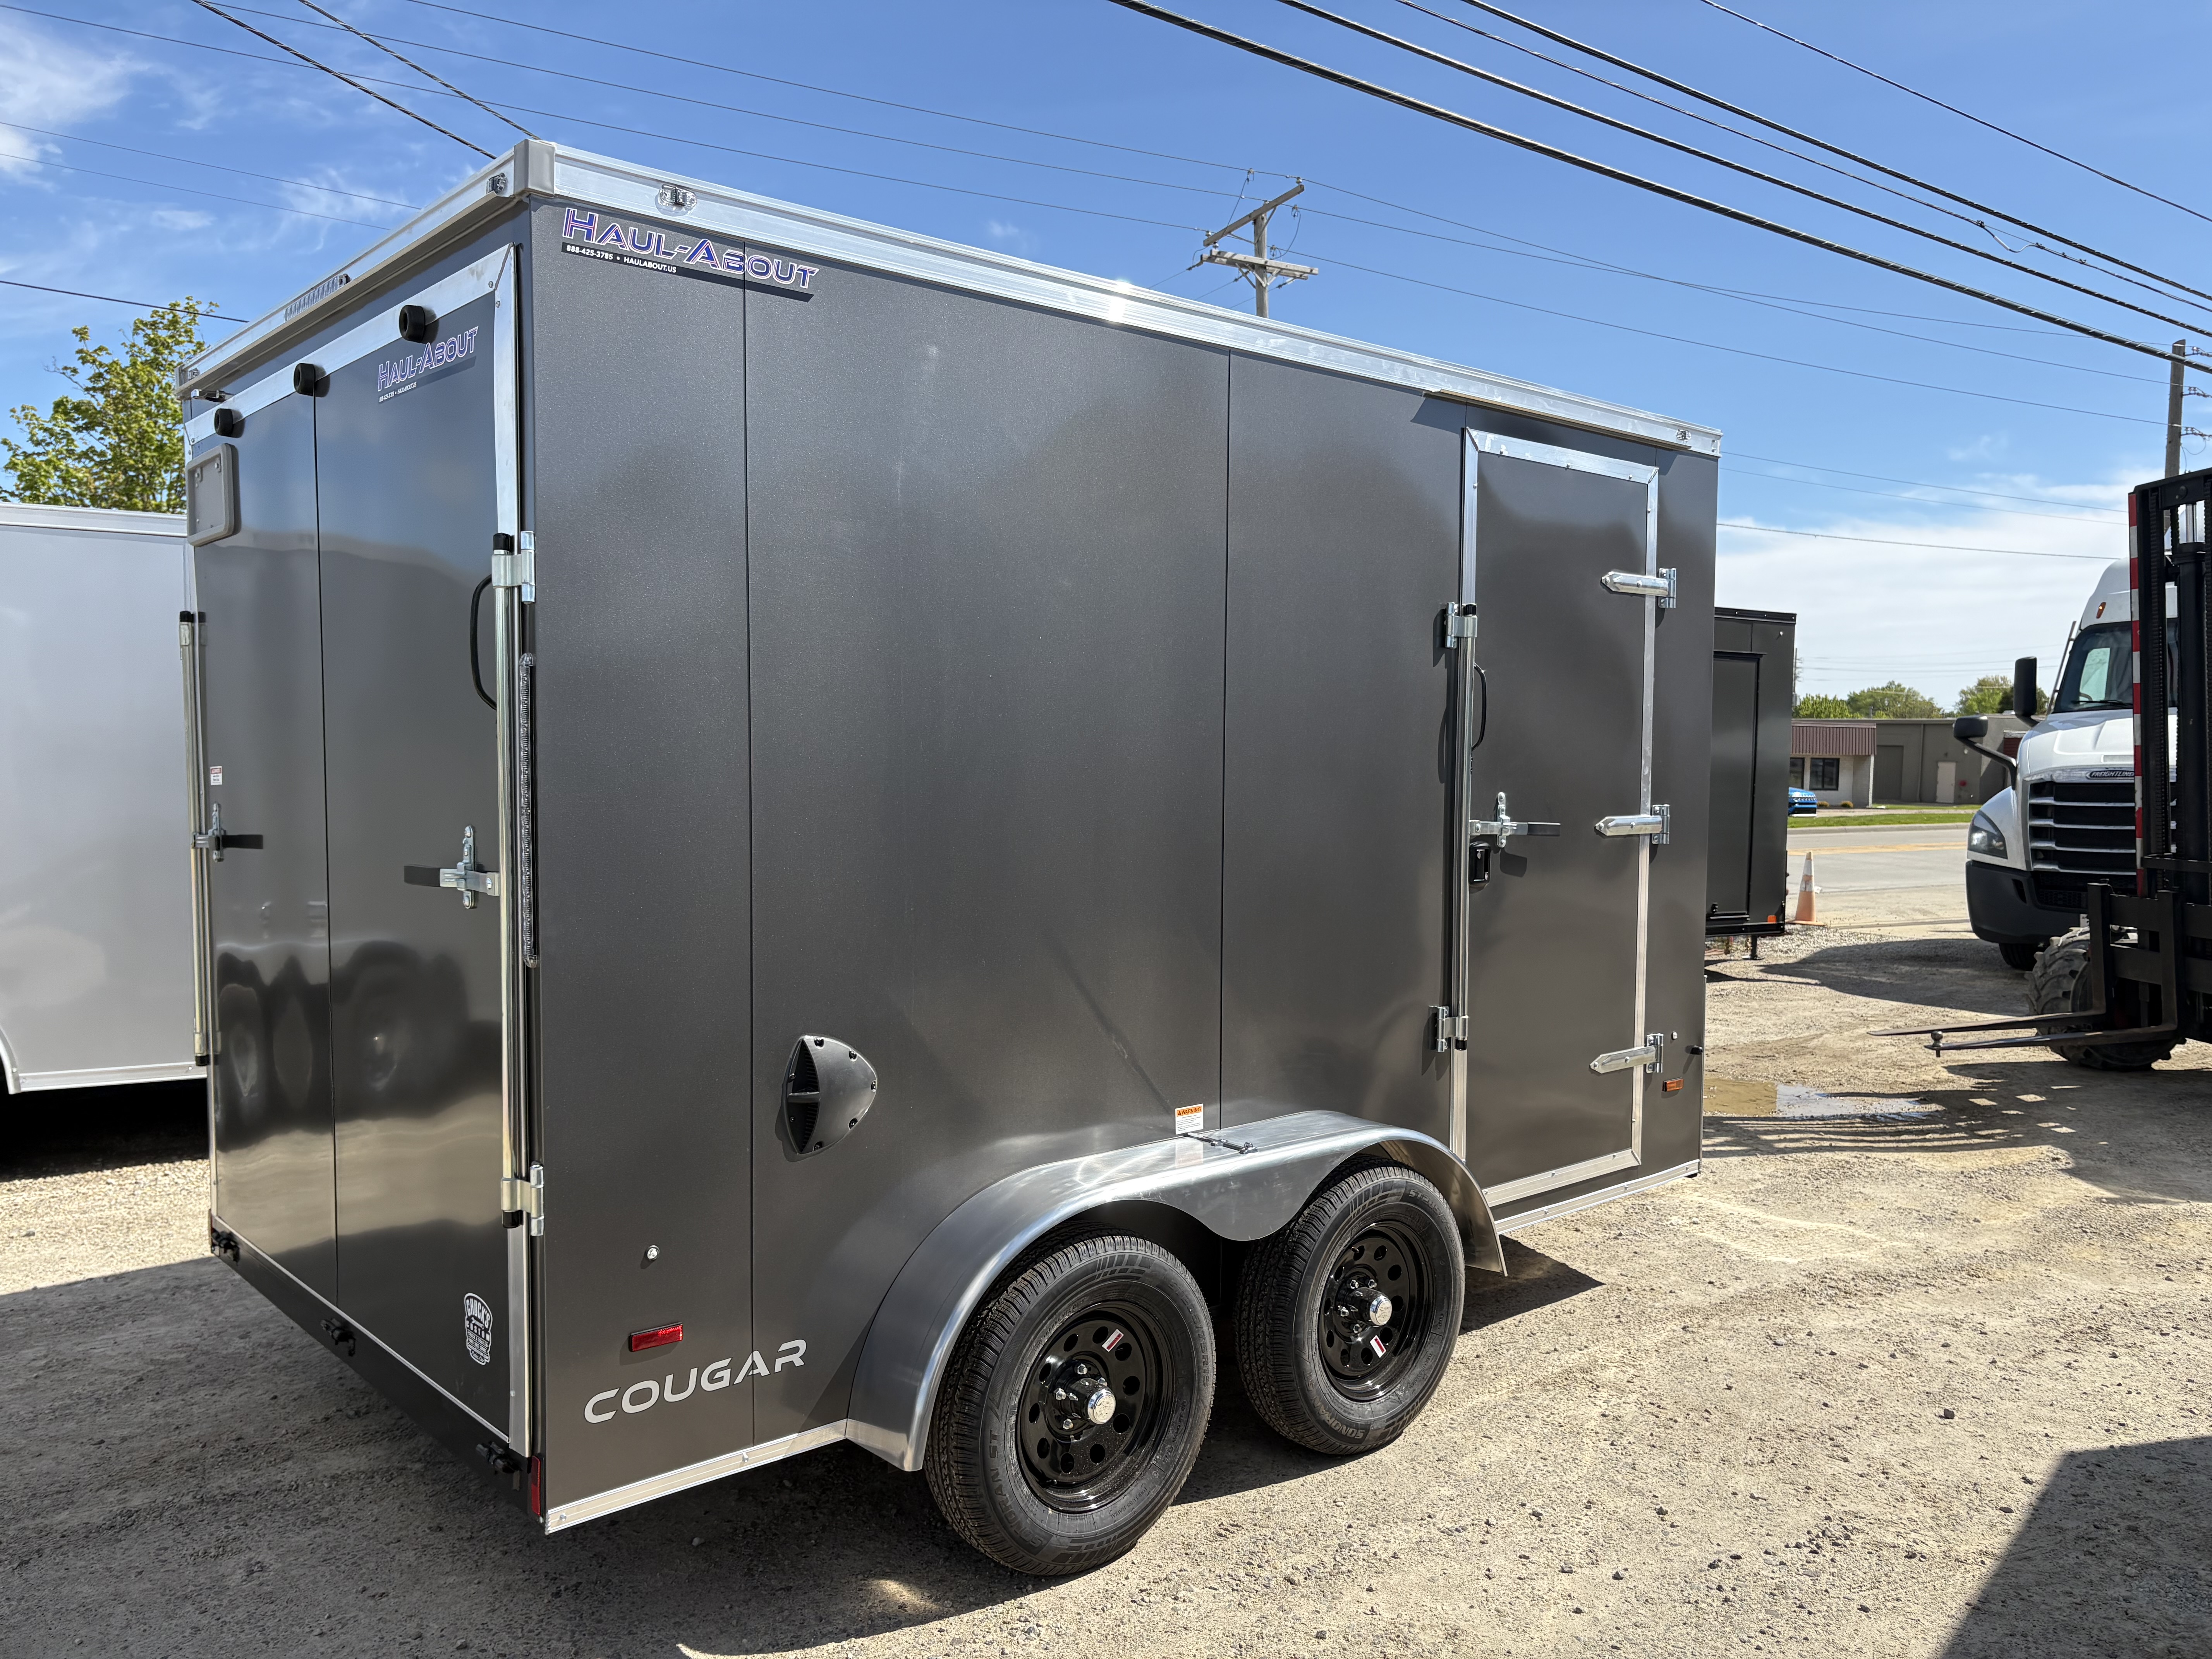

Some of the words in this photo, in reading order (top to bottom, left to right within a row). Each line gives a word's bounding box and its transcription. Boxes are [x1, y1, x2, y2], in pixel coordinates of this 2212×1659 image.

[562, 208, 819, 289] HAUL-ABOUT
[567, 245, 613, 260] 888-425-3785
[624, 257, 677, 273] HAULABOUT.US
[378, 326, 479, 392] HAUL-ABOUT
[466, 1298, 490, 1329] CHUCK'S
[584, 1339, 807, 1424] COUGAR
[990, 1468, 1044, 1547] SONORAN
